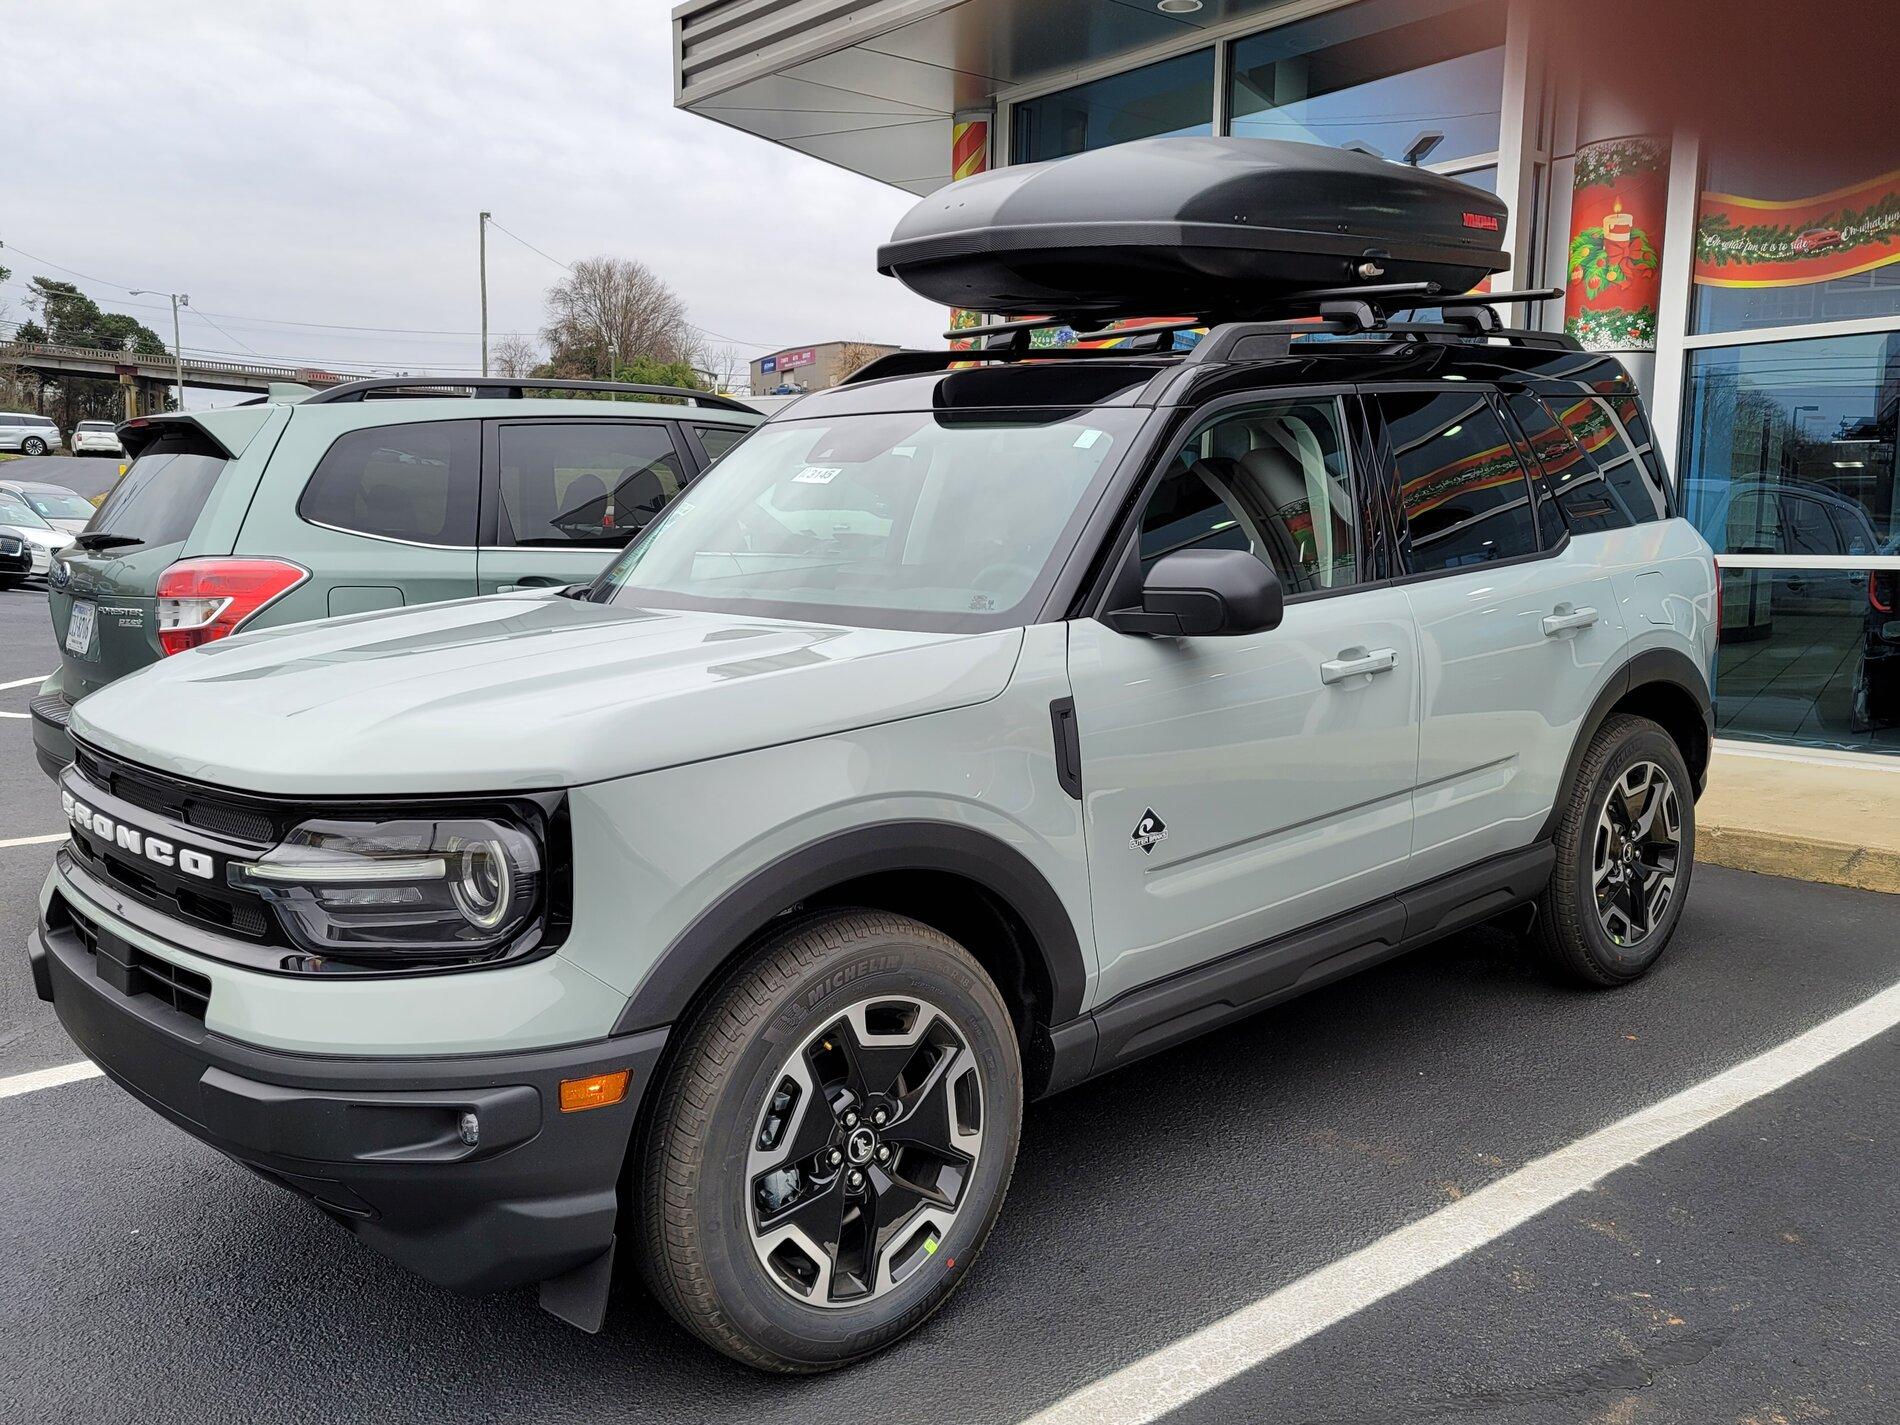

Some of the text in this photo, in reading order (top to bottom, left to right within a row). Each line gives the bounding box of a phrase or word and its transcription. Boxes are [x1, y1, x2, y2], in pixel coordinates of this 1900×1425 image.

[1706, 234, 1721, 247] Oh
[1760, 242, 1769, 251] it
[1770, 243, 1778, 251] is
[1779, 242, 1788, 251] to
[61, 790, 214, 880] BRONCO
[807, 955, 900, 1006] MICHELIN
